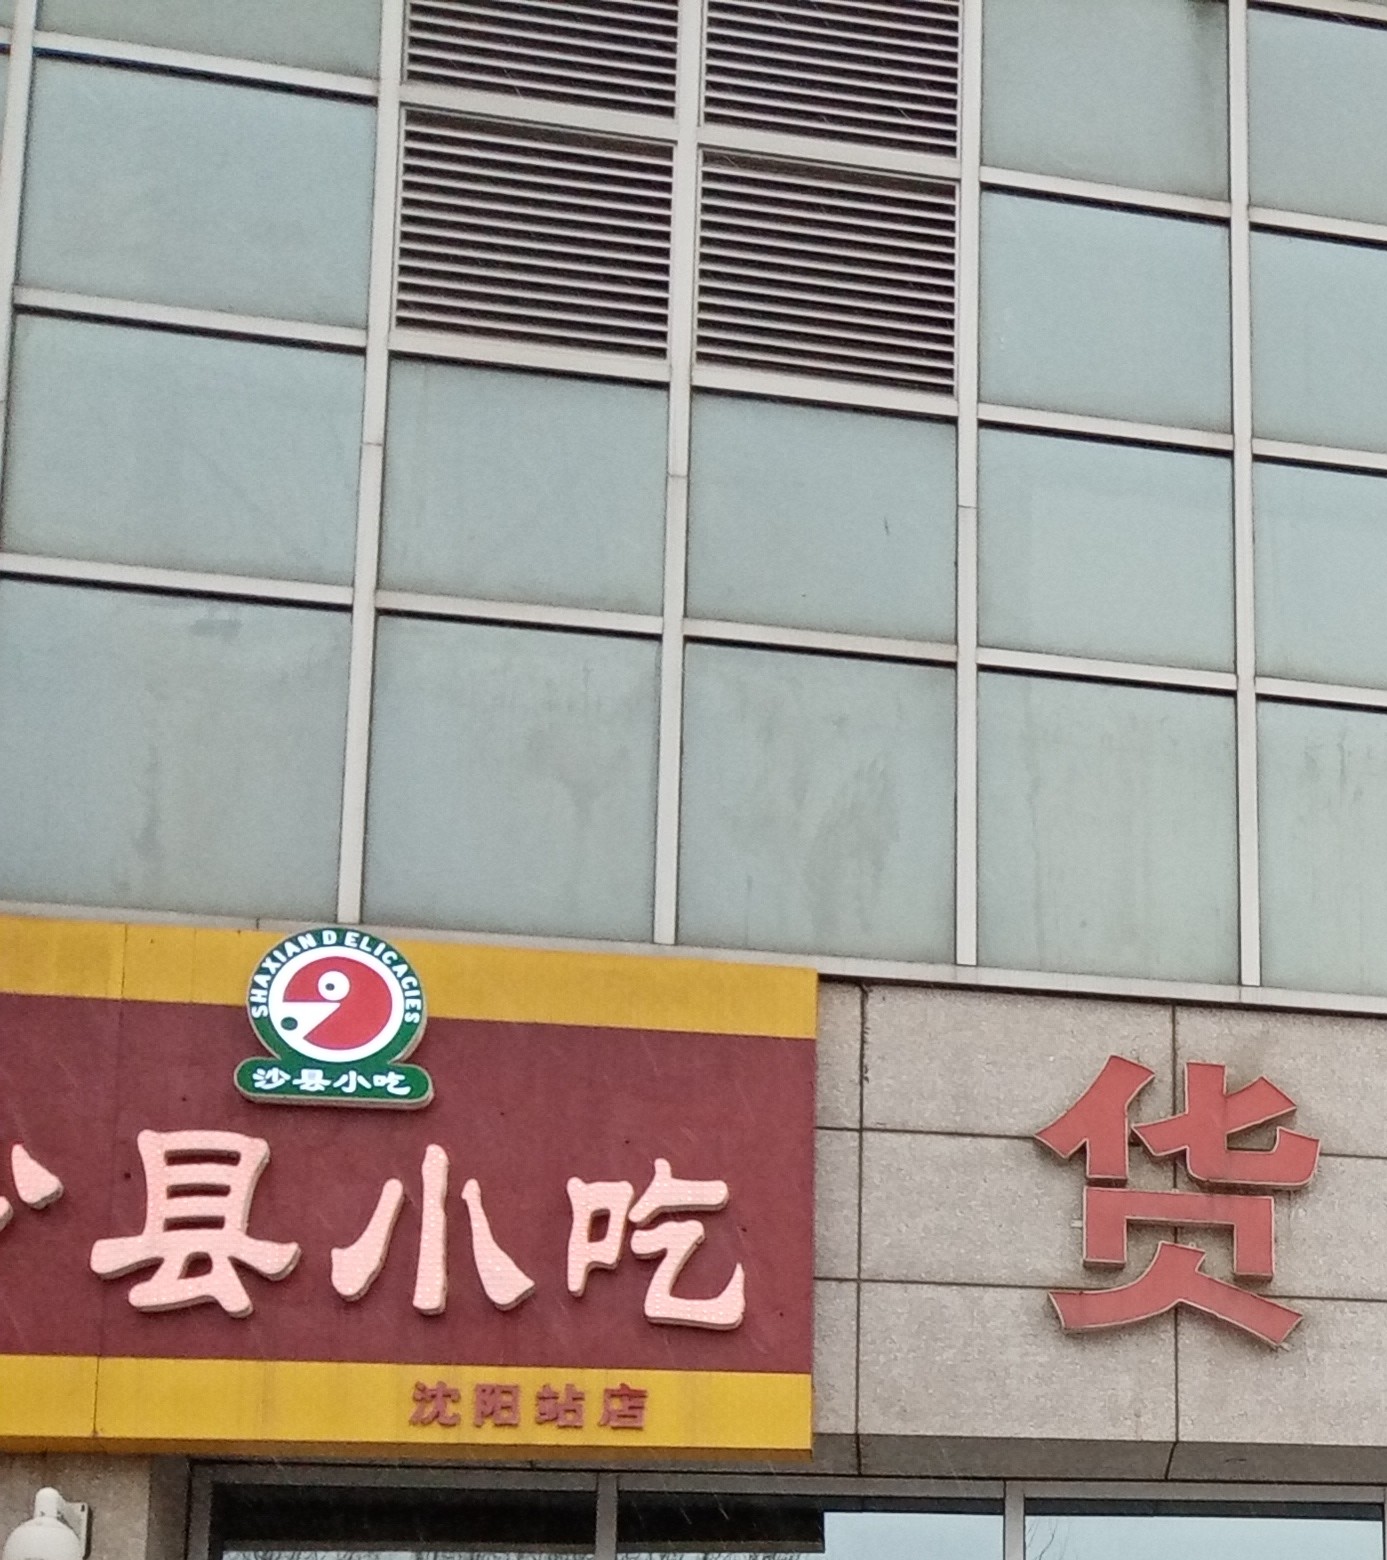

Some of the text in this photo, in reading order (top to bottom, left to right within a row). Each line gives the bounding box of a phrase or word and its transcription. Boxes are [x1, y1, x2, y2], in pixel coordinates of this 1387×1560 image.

[249, 929, 422, 1024] SHAXIAN DELICACIES
[252, 1067, 411, 1095] 沙县小吃
[408, 1381, 648, 1431] 沈阳站店
